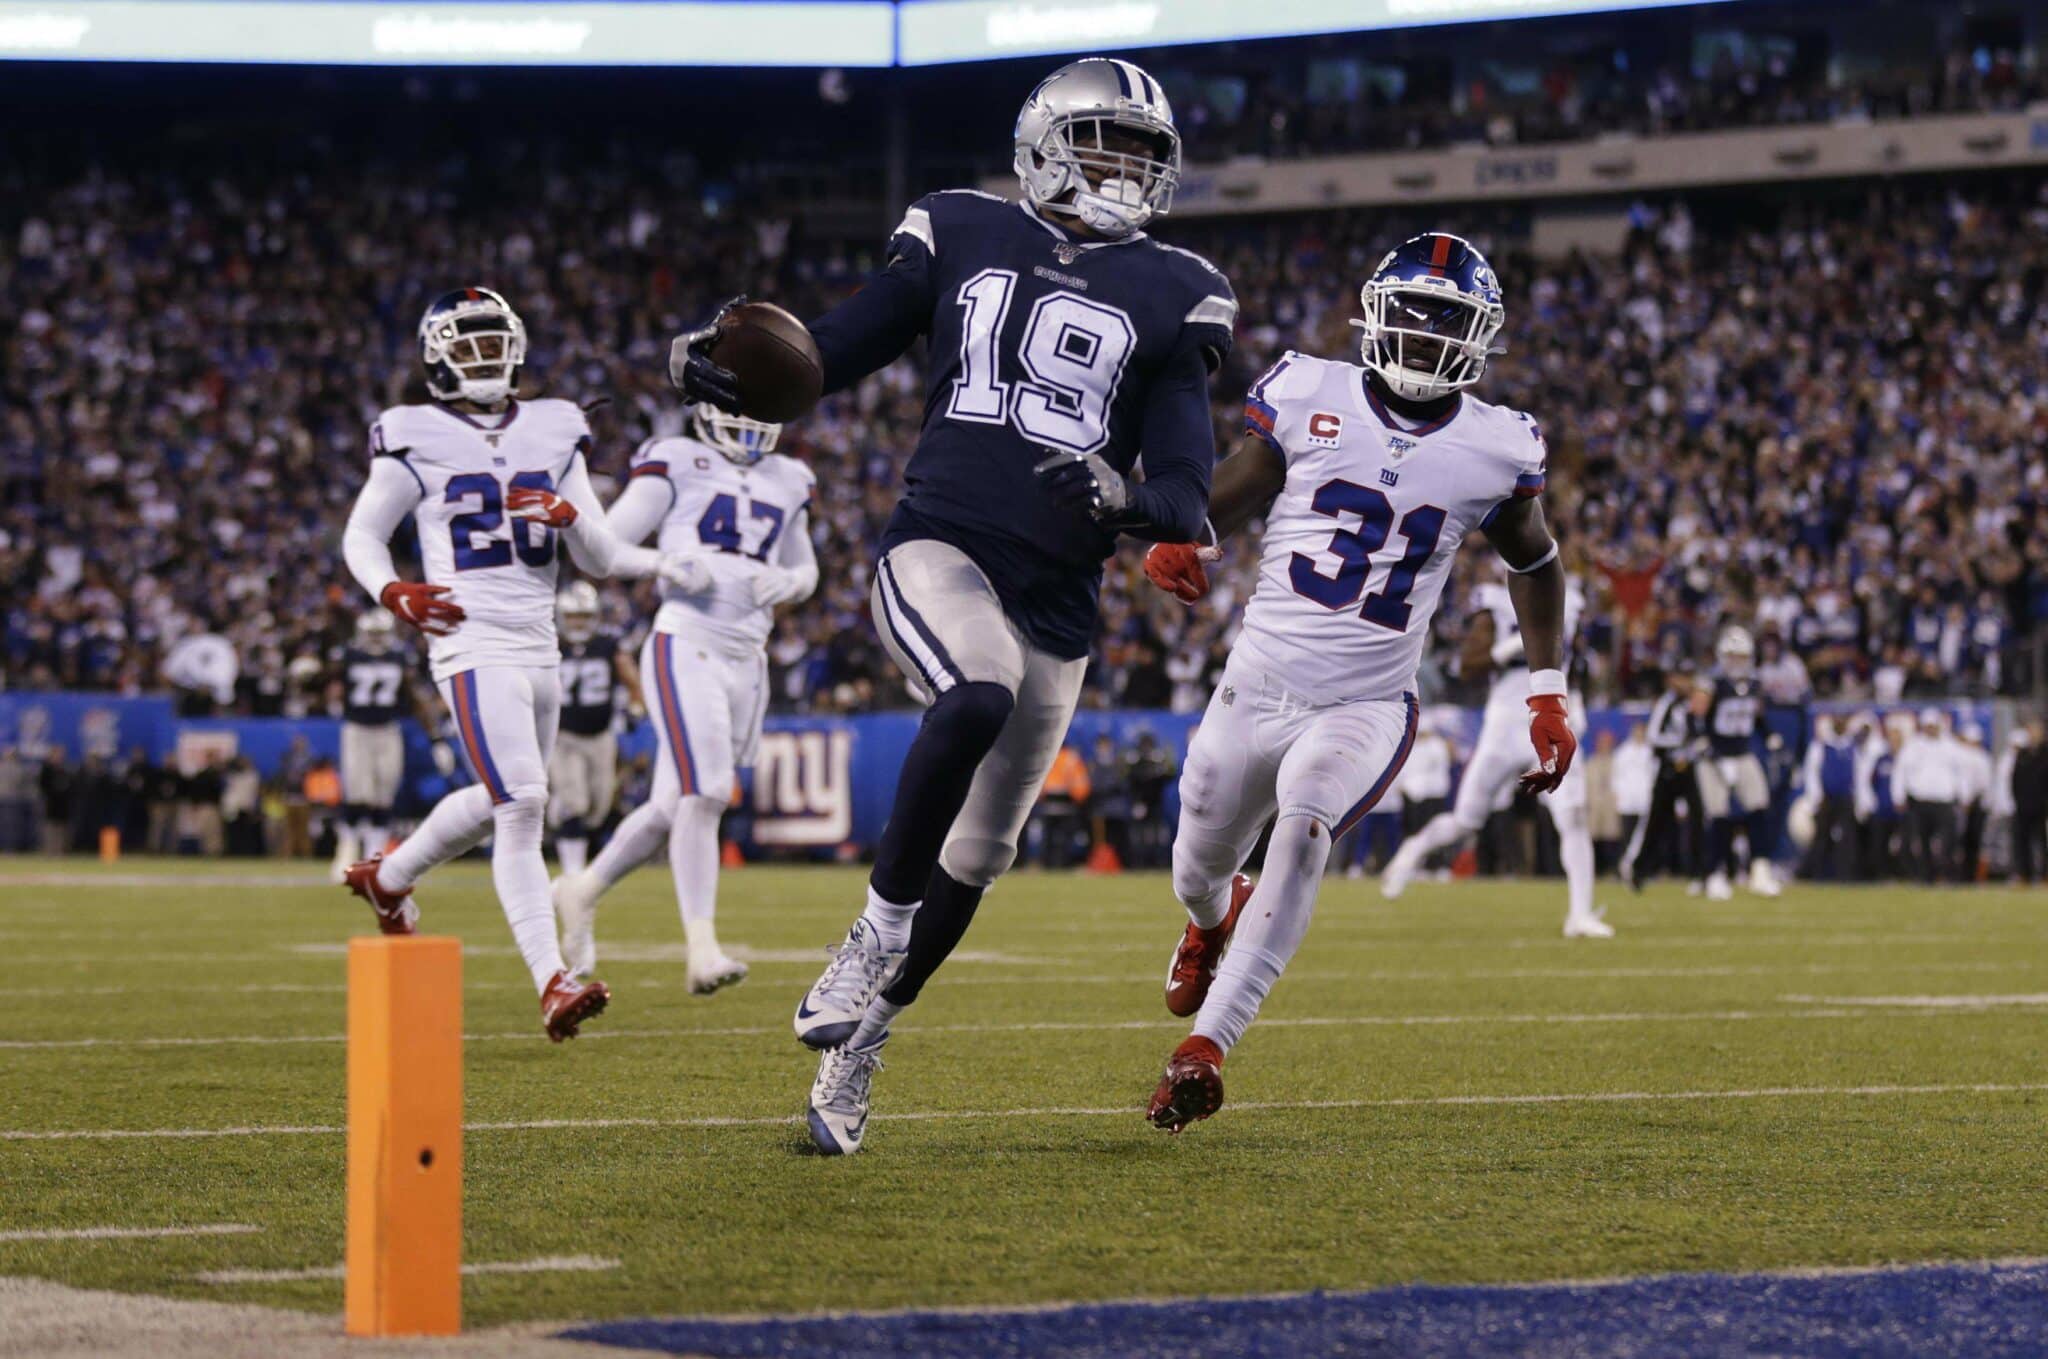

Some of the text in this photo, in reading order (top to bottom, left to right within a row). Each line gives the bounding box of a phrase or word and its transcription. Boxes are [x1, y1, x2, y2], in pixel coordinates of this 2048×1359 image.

[945, 268, 1137, 454] 19
[1309, 413, 1341, 438] C
[693, 457, 710, 471] C
[697, 492, 784, 565] 47
[1288, 478, 1447, 632] 31
[347, 663, 403, 707] 77
